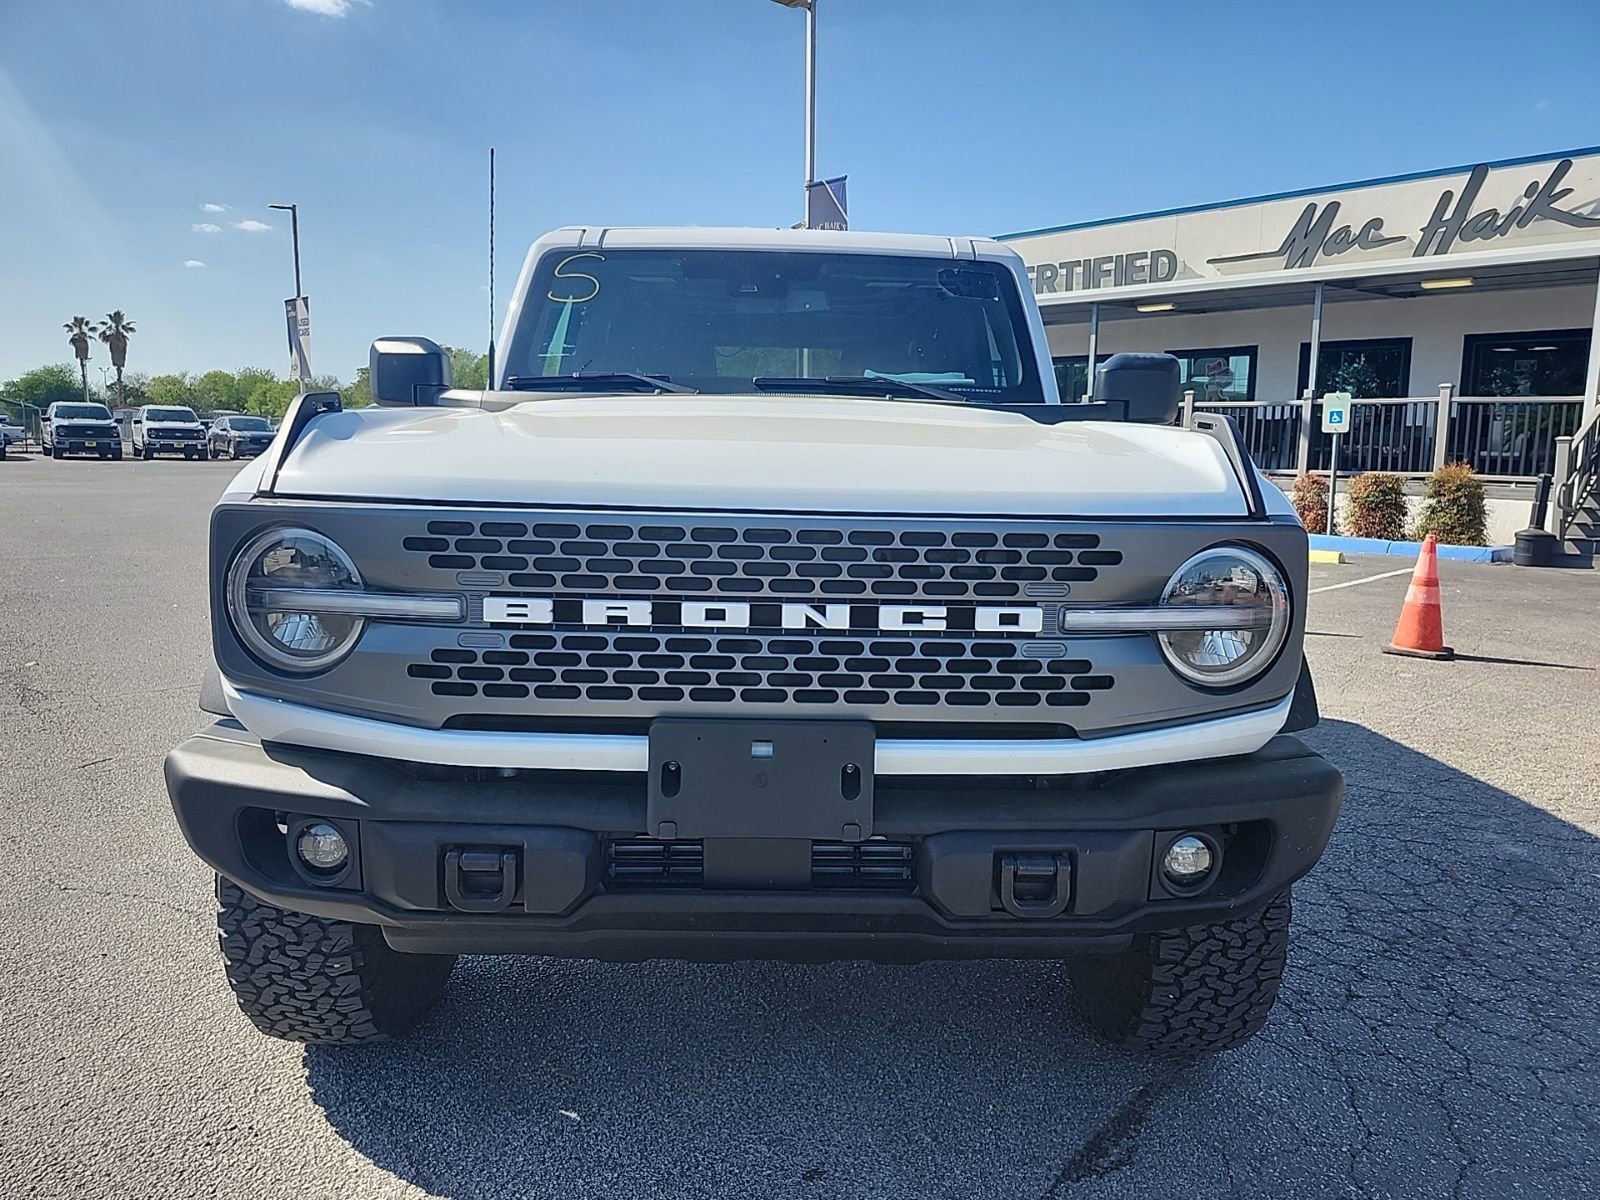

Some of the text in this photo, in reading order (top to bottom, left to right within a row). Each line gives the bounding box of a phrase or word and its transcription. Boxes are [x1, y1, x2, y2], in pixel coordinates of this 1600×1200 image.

[1207, 159, 1600, 269] Mac Haik
[1026, 249, 1178, 295] RTIFIED
[482, 596, 1044, 632] BRONCO
